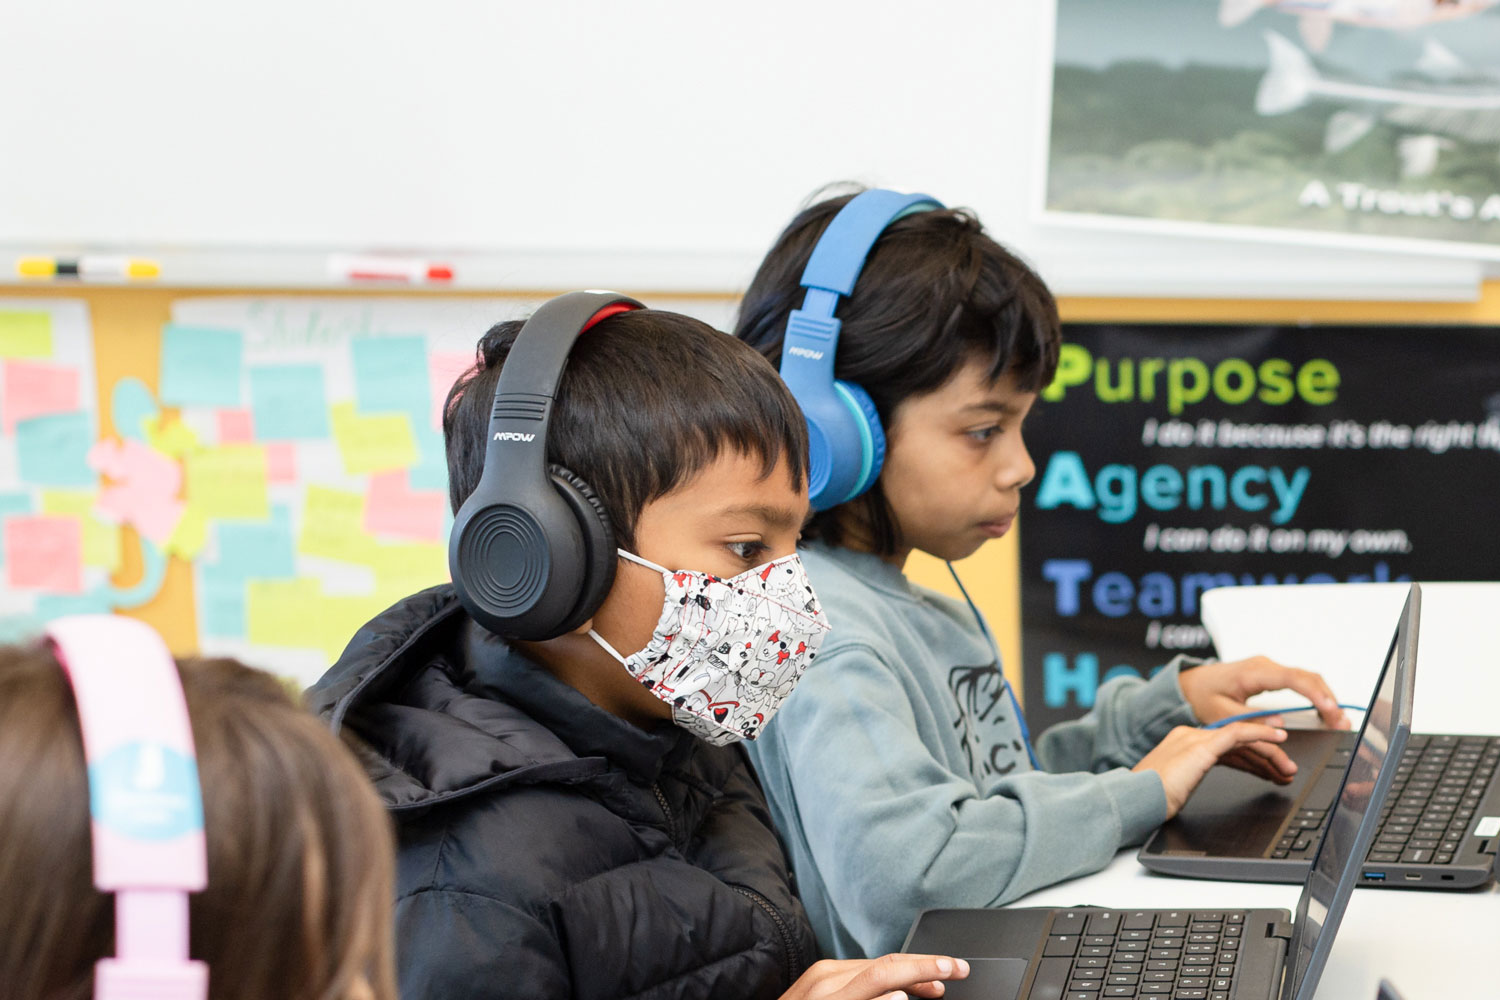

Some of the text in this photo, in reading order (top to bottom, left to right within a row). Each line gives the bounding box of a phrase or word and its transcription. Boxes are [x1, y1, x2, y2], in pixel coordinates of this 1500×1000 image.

[1299, 180, 1331, 207] A
[1337, 182, 1474, 220] Trout's
[1041, 343, 1341, 416] Purpose
[493, 432, 536, 443] MPOW
[1142, 417, 1158, 446] I
[1157, 418, 1196, 447] do
[1196, 418, 1217, 447] it
[1217, 418, 1326, 448] because
[1327, 419, 1366, 449] it's
[1368, 420, 1413, 449] the
[1414, 420, 1475, 454] right
[1035, 450, 1311, 525] Agency
[1143, 523, 1413, 559] I can do it on my own.
[1146, 621, 1160, 648] I
